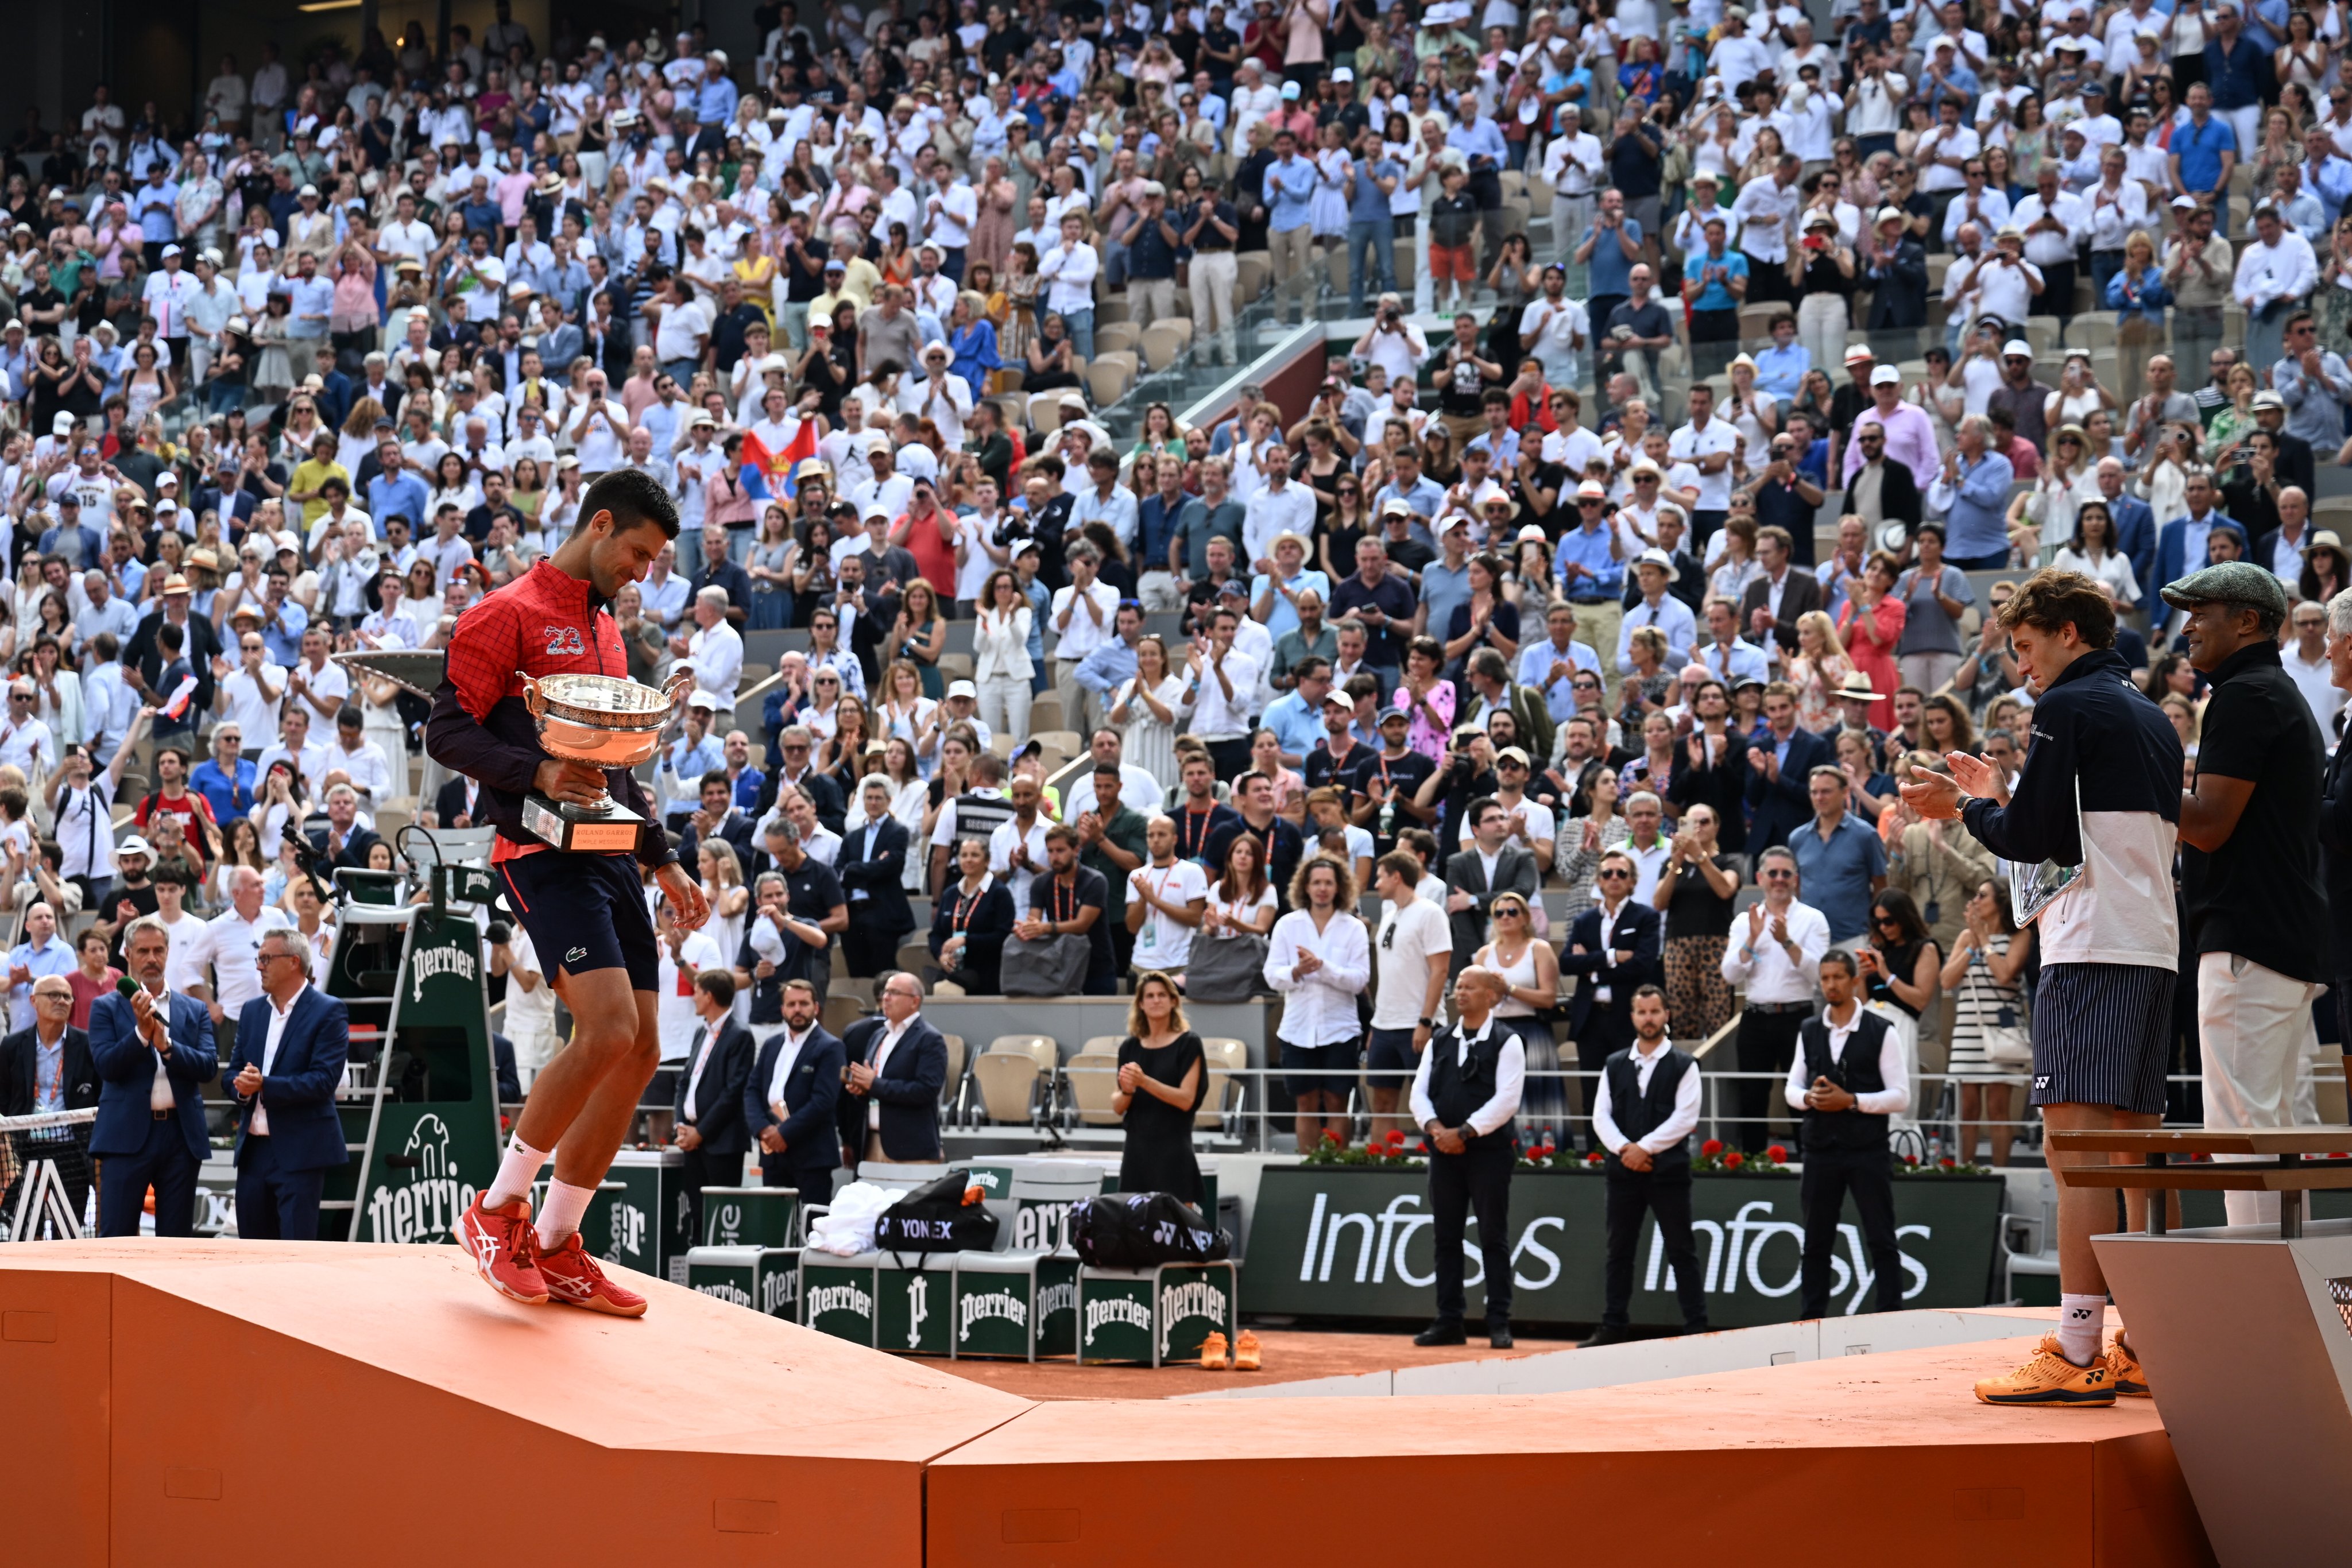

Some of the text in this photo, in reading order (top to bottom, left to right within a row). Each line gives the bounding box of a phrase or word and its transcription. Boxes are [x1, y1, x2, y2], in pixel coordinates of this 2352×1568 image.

[82, 494, 96, 506] 15
[544, 626, 585, 655] 23
[900, 1218, 953, 1240] YONEX
